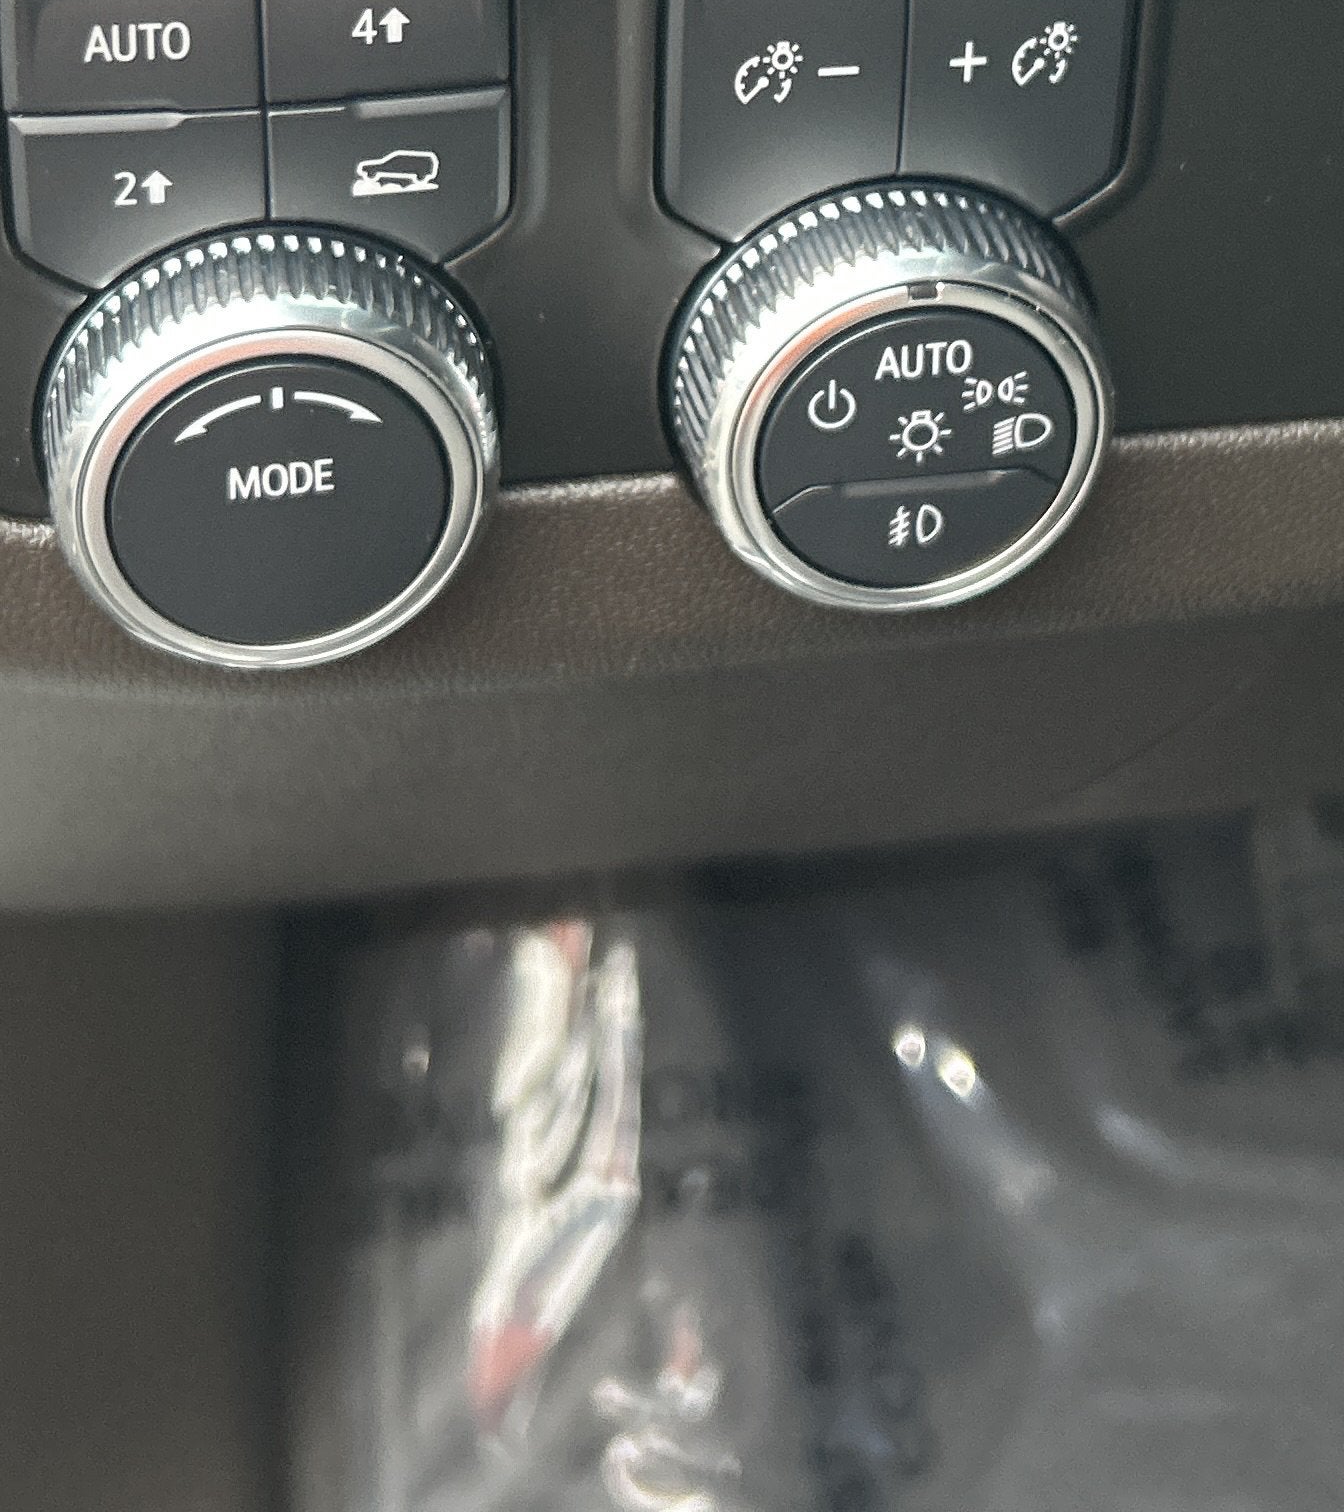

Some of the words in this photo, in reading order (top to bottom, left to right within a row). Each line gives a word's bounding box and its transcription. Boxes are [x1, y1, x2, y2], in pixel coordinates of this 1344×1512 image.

[83, 21, 192, 63] AUTO
[351, 8, 378, 46] 4
[112, 171, 139, 207] 2
[874, 338, 974, 382] AUTO
[227, 458, 336, 501] MODE
